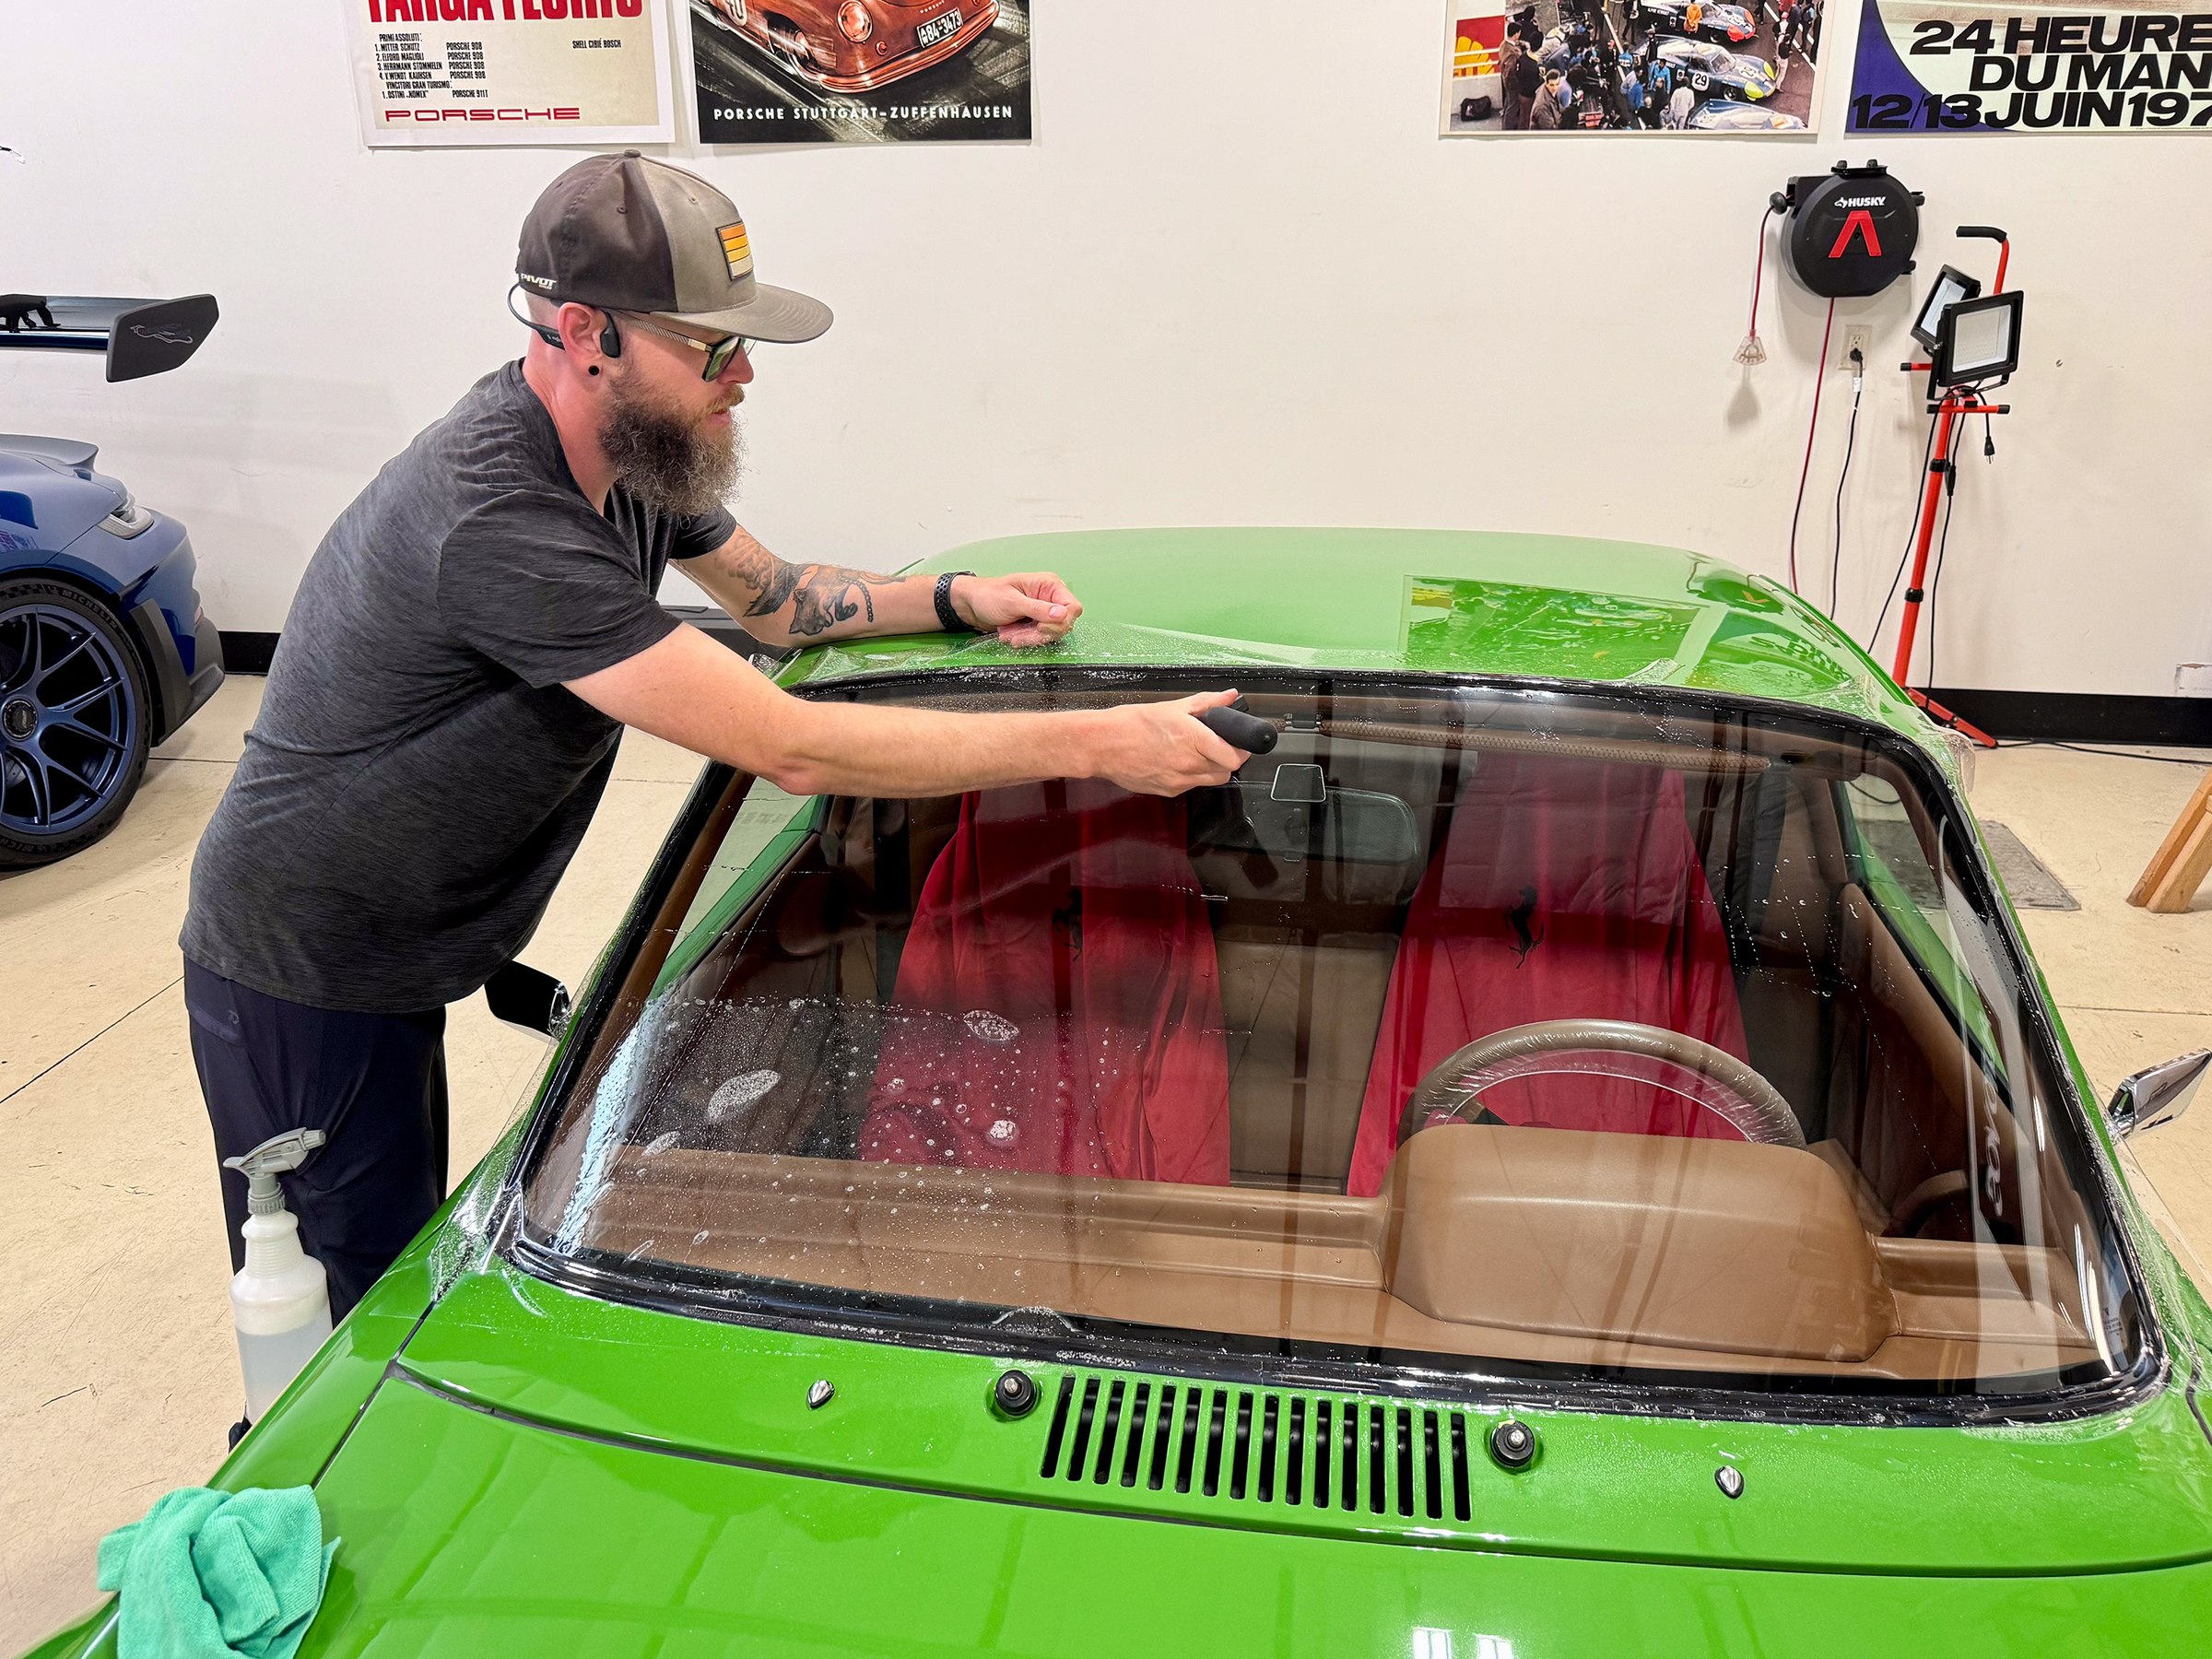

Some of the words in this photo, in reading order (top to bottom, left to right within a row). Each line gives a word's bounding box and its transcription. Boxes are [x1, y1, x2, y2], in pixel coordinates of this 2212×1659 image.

[1910, 19, 1995, 55] 24
[446, 41, 470, 50] PORSCHE
[471, 41, 482, 50] 908
[572, 40, 587, 49] SHELL
[604, 40, 621, 48] BOSCH
[447, 52, 471, 60] PORSCHE
[473, 52, 484, 60] 908
[449, 61, 473, 69] PORSCHE
[474, 61, 485, 69] 908
[450, 71, 474, 79] PORSCHE
[475, 71, 486, 79] 908
[1969, 55, 2056, 91] DU
[1694, 73, 1707, 86] 29
[452, 89, 476, 98] PORSCHE
[384, 108, 581, 122] PORSCHE
[713, 108, 783, 120] PORSCHE
[1852, 93, 1983, 129] 12/13
[1984, 91, 2126, 128] JUIN
[1848, 196, 1887, 207] HUSKY
[521, 273, 558, 286] PIVOT
[62, 589, 118, 629] MICHELIN
